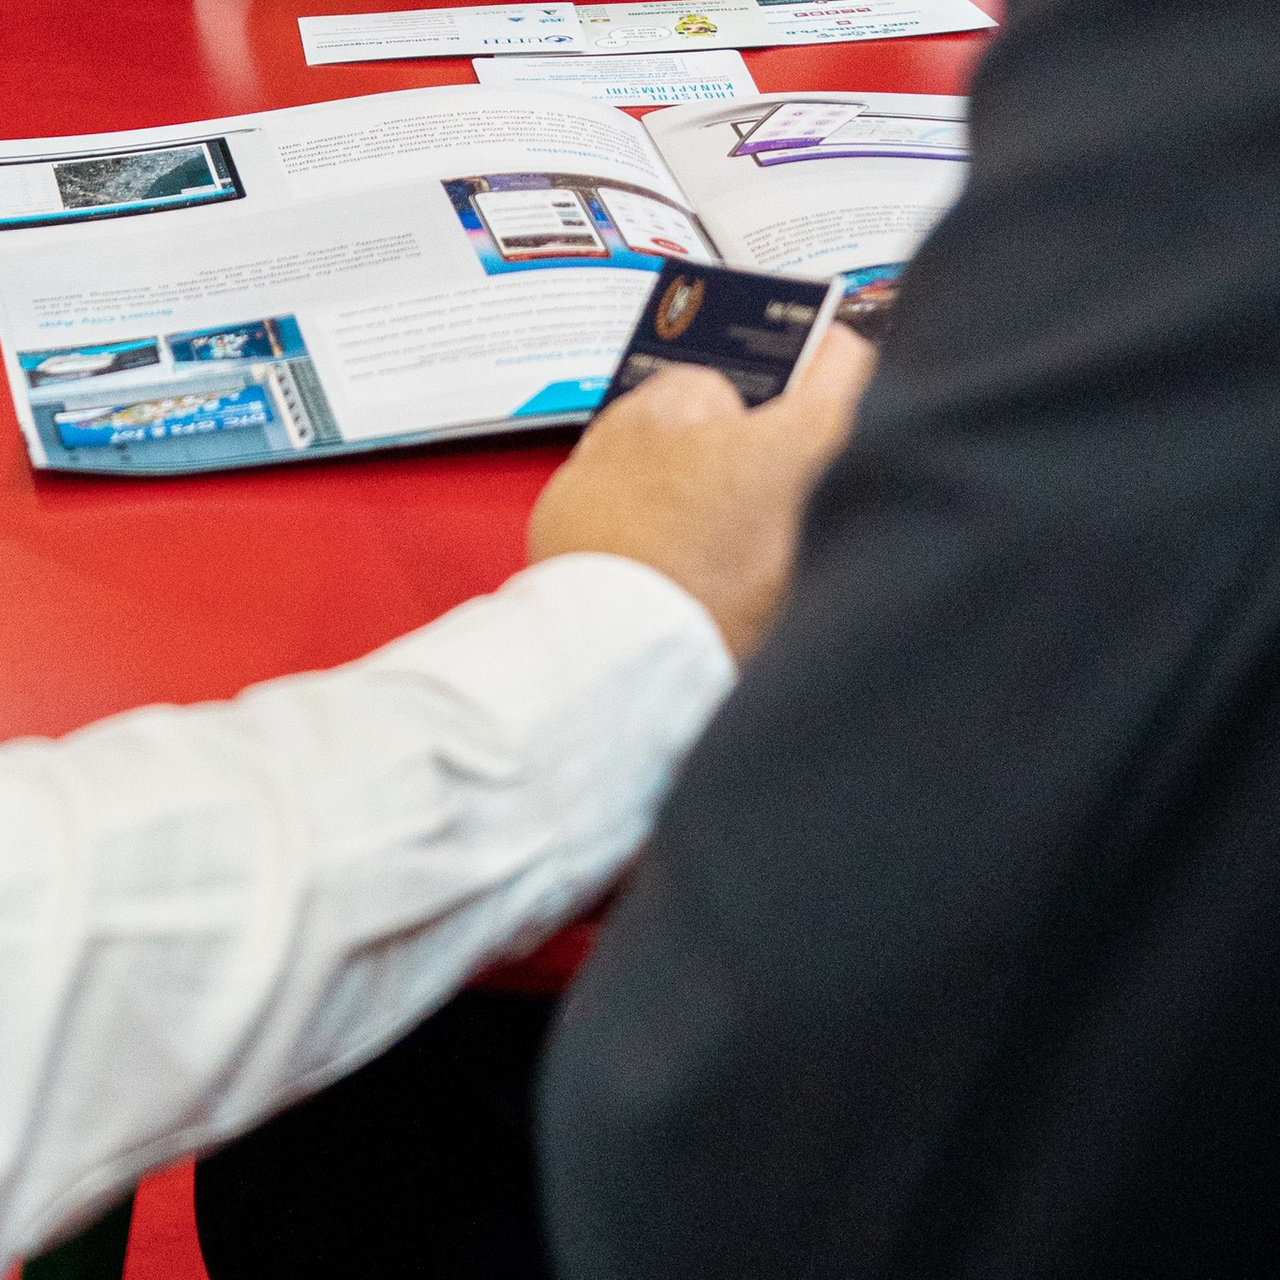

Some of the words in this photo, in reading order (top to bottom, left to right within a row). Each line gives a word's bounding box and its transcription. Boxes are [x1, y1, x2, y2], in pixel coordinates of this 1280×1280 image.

[606, 83, 734, 95] KUNAPERMSIRI
[307, 131, 365, 145] consistent
[365, 133, 435, 146] Applications
[283, 149, 339, 162] employed
[285, 153, 352, 168] Geographic
[339, 152, 394, 164] collection
